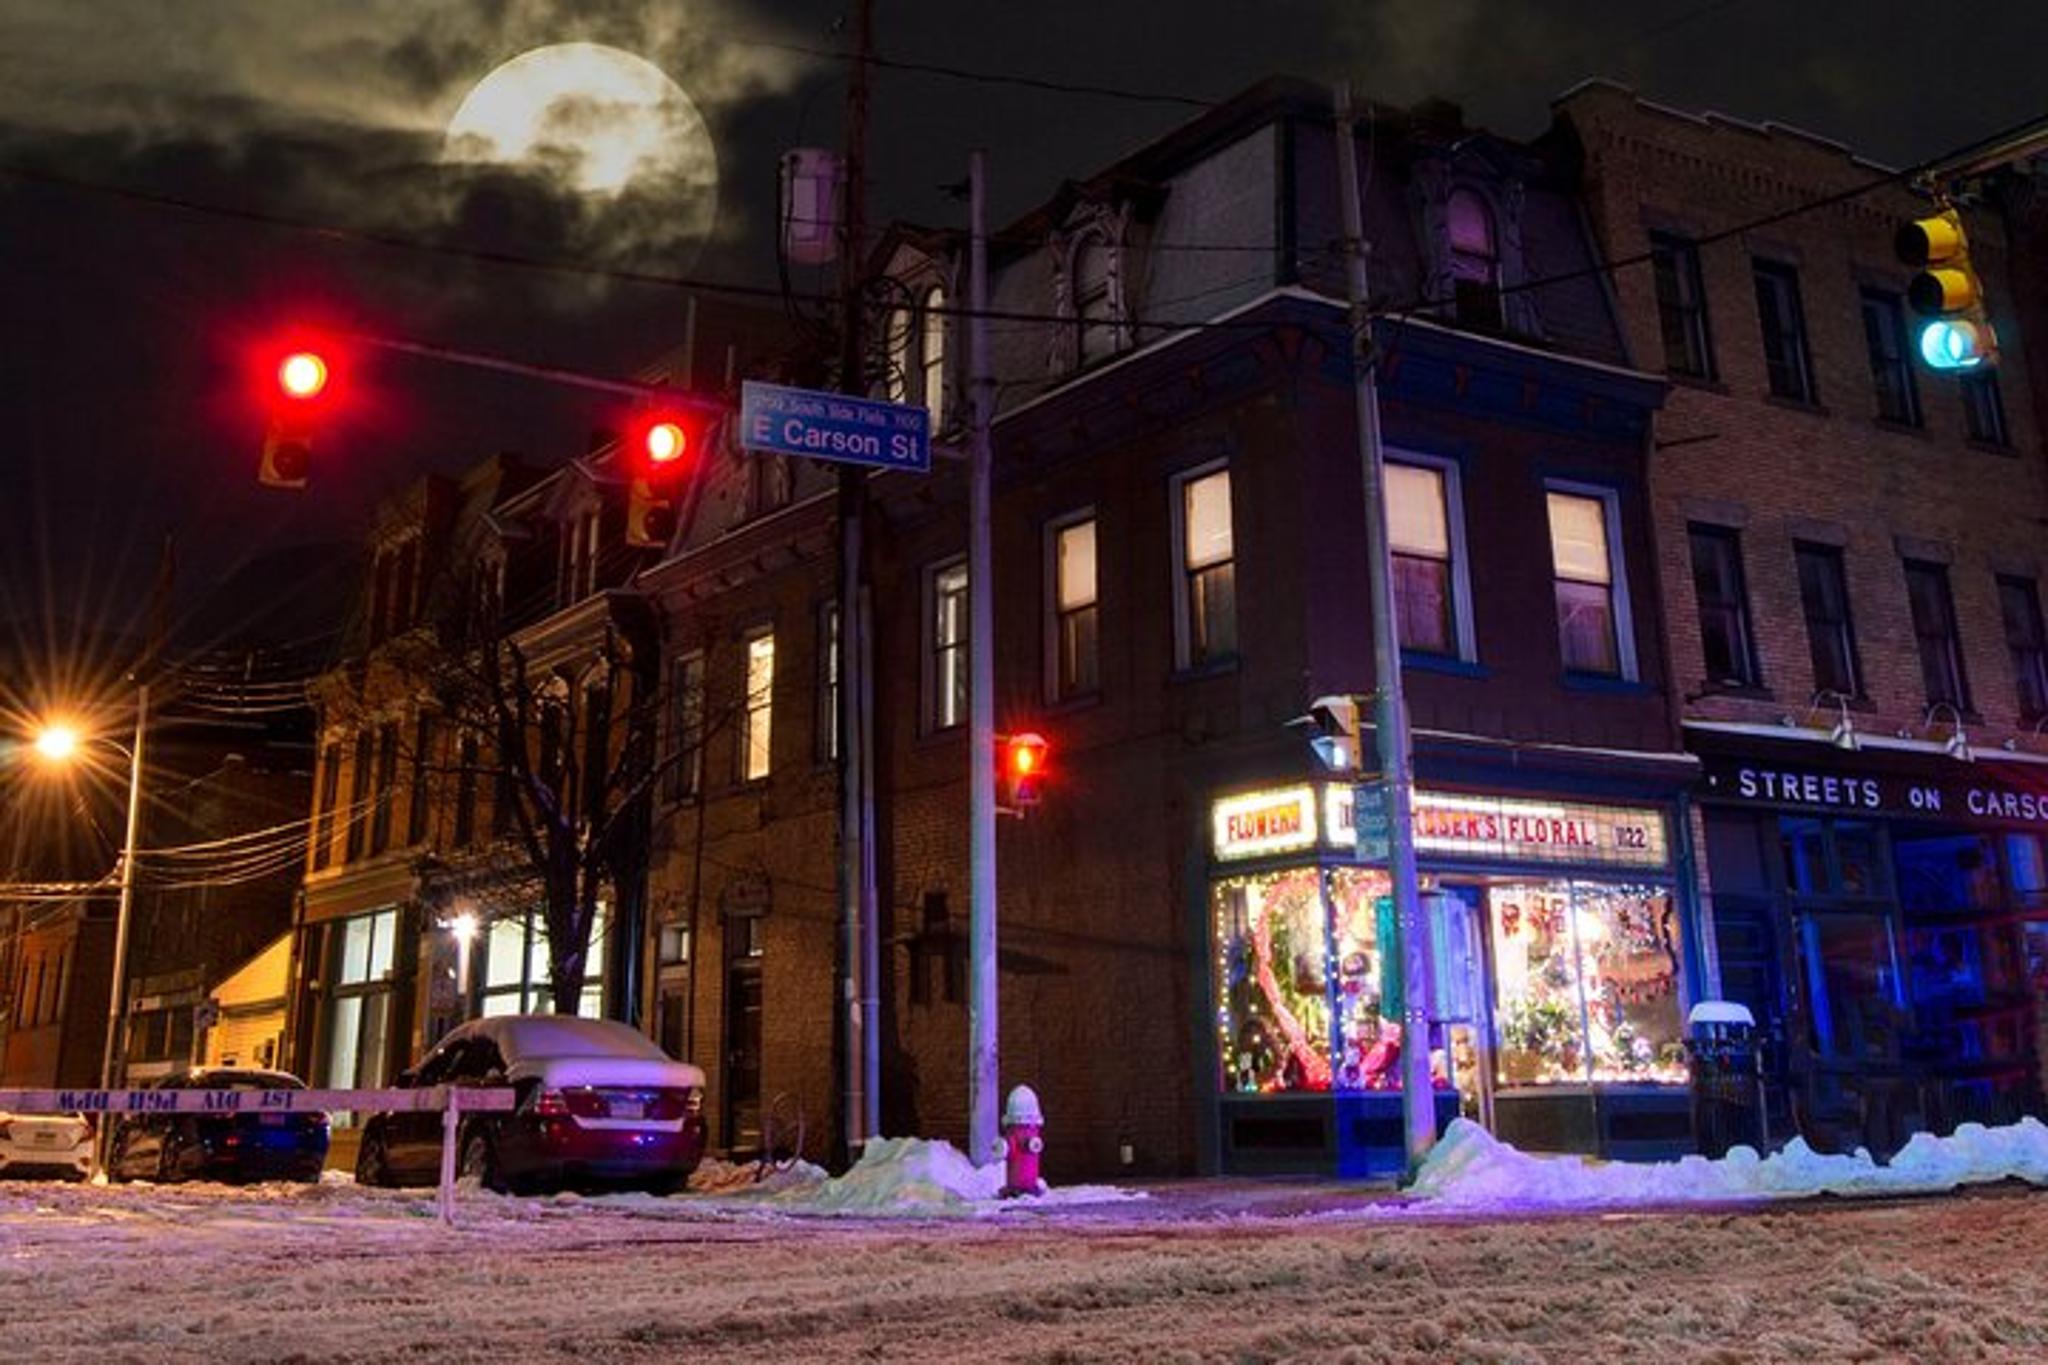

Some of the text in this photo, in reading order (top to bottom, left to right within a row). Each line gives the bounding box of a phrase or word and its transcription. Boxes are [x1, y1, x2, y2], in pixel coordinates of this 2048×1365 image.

[753, 416, 919, 461] E Carson St
[1739, 769, 1880, 807] STREETS
[1909, 787, 1941, 811] ON
[1509, 816, 1593, 846] FLORAL
